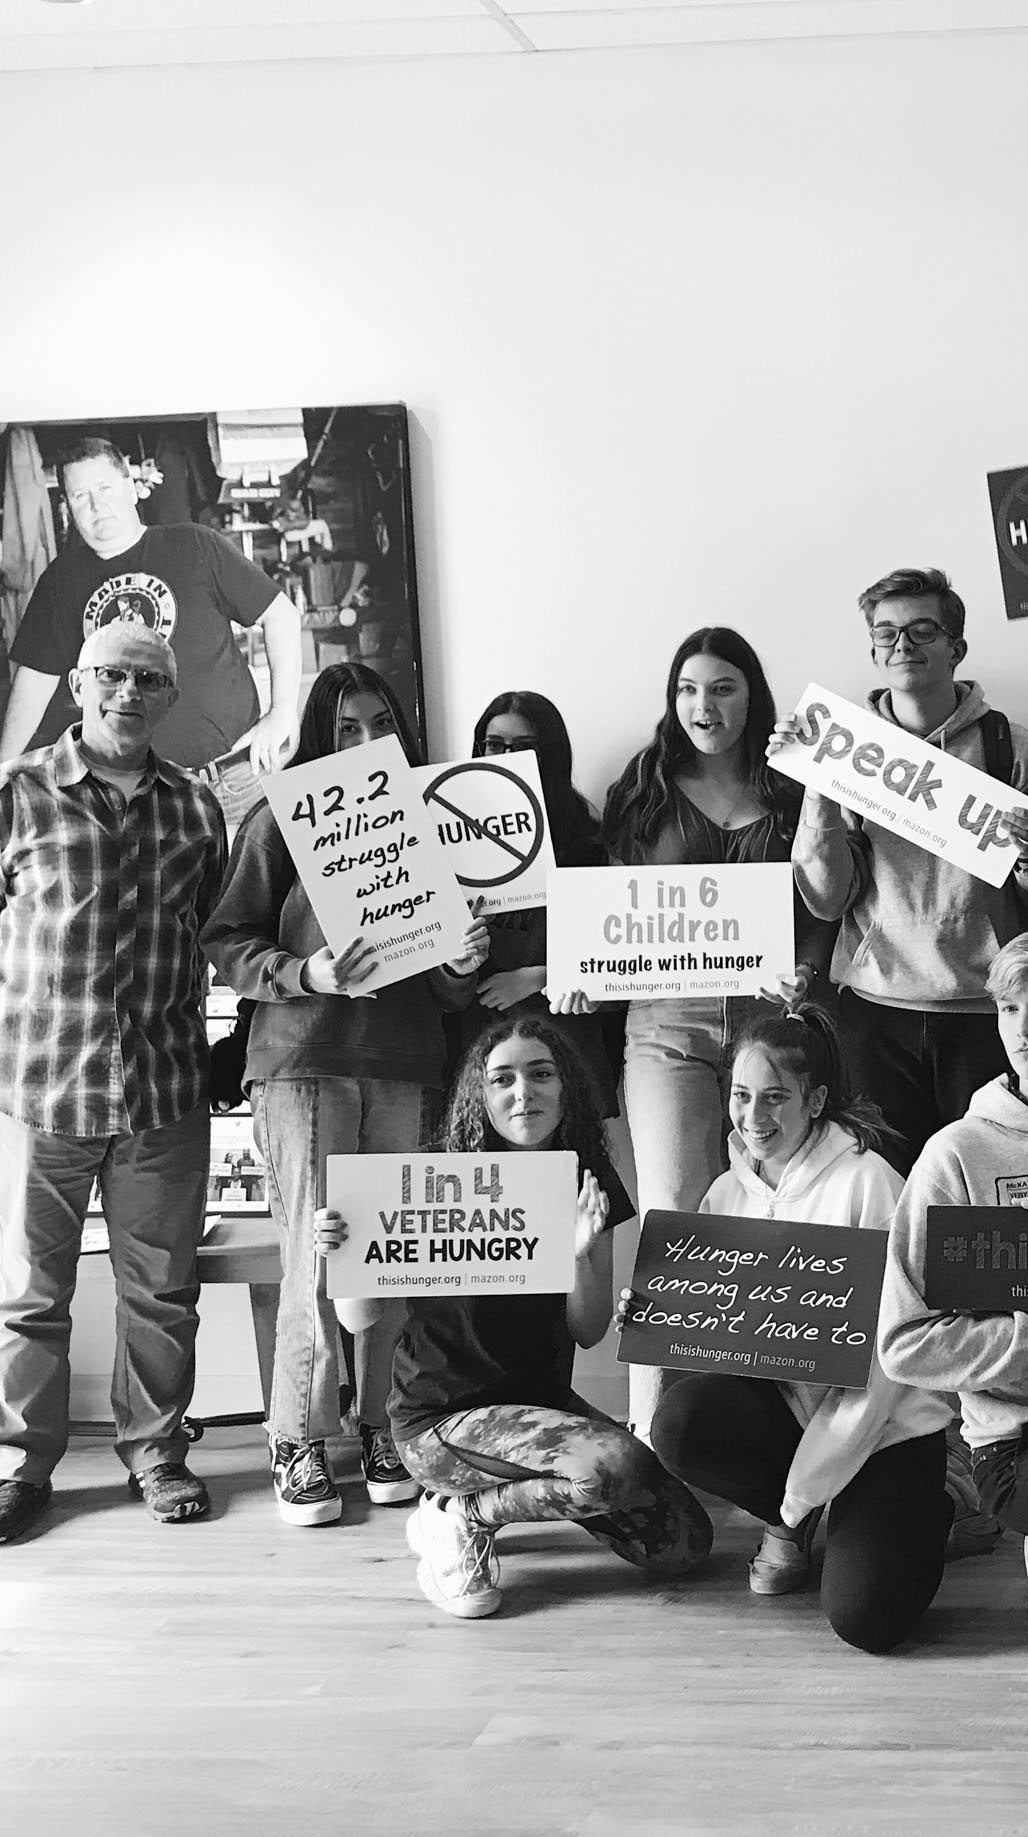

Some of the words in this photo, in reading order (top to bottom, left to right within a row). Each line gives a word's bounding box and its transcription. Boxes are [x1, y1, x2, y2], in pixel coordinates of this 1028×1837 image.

[147, 578, 167, 599] IN
[796, 702, 943, 811] Speak
[958, 793, 1012, 852] up
[291, 770, 390, 828] 42.2
[831, 779, 897, 822] thisishunger.org
[902, 815, 948, 849] mazon.org
[313, 809, 405, 851] million
[321, 832, 420, 877] struggle
[356, 867, 410, 898] with
[627, 878, 639, 910] 1
[657, 880, 686, 909] in
[699, 876, 719, 908] 6
[360, 890, 436, 926] hunger
[603, 912, 740, 945] Children
[384, 939, 435, 962] mazon.org
[580, 954, 653, 976] struggle
[658, 952, 698, 971] with
[702, 952, 764, 972] hunger
[605, 981, 681, 993] thisishunger.org
[689, 979, 740, 991] mazon.org
[425, 1166, 462, 1204] in
[474, 1163, 504, 1203] 4
[379, 1207, 526, 1234] VETERANS
[364, 1239, 419, 1264] ARE
[429, 1237, 539, 1262] HUNGRY
[664, 1235, 769, 1276] Hunger
[778, 1245, 848, 1275] lives
[377, 1275, 461, 1287] thisishunger.org
[471, 1273, 526, 1284] mazon.org
[647, 1275, 739, 1310] among
[748, 1285, 792, 1303] us
[800, 1287, 854, 1309] and
[632, 1301, 746, 1334] doesn't
[754, 1313, 819, 1341] have
[831, 1322, 867, 1345] to
[669, 1343, 751, 1365] thisishunger.org
[760, 1354, 816, 1372] mazon.org
